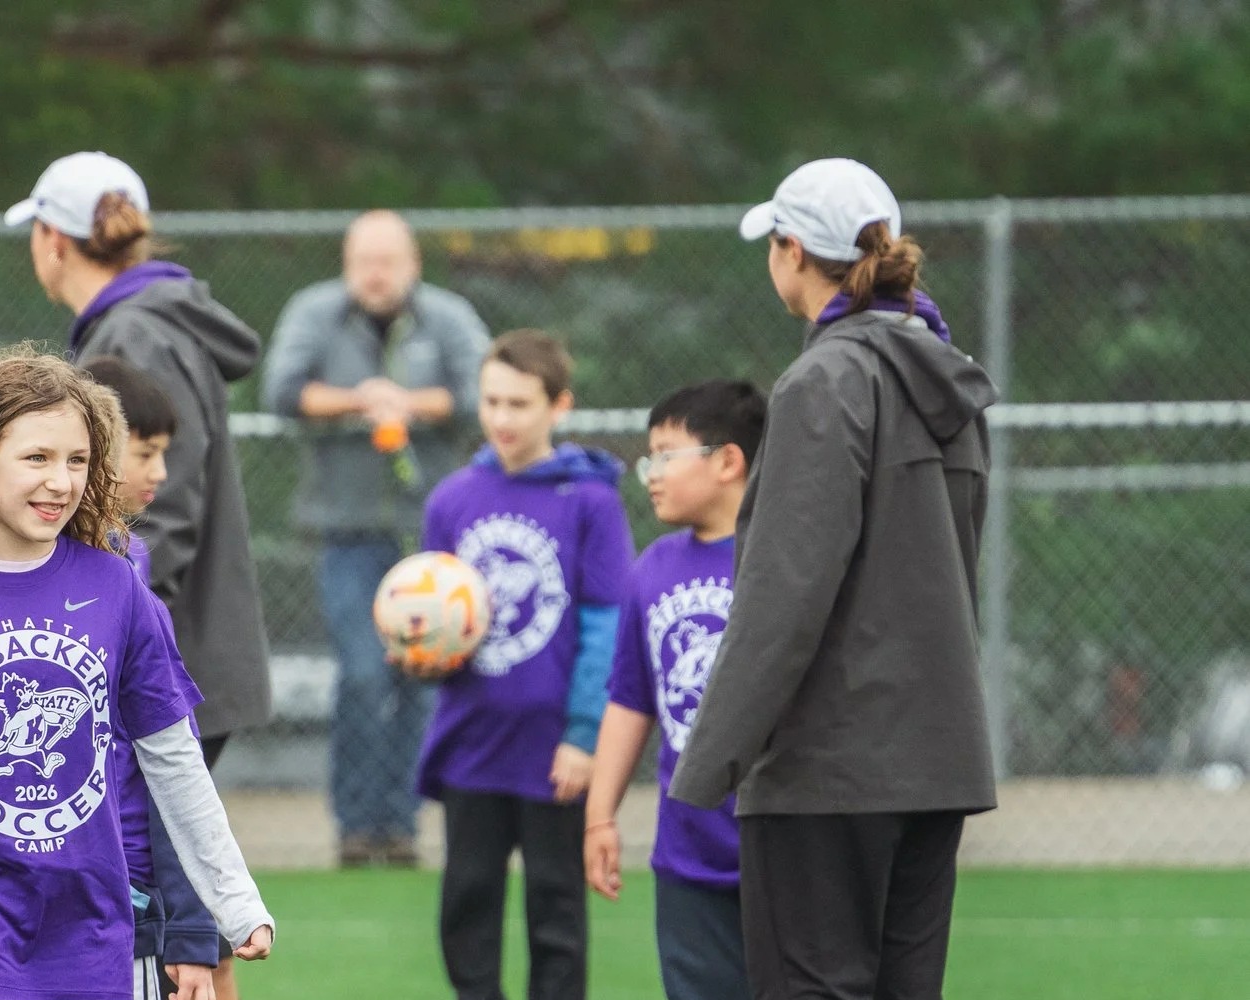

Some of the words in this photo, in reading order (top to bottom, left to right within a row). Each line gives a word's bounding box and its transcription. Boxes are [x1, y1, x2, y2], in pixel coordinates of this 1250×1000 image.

[25, 713, 44, 745] K
[15, 784, 58, 802] 2026
[14, 837, 66, 854] CAMP
